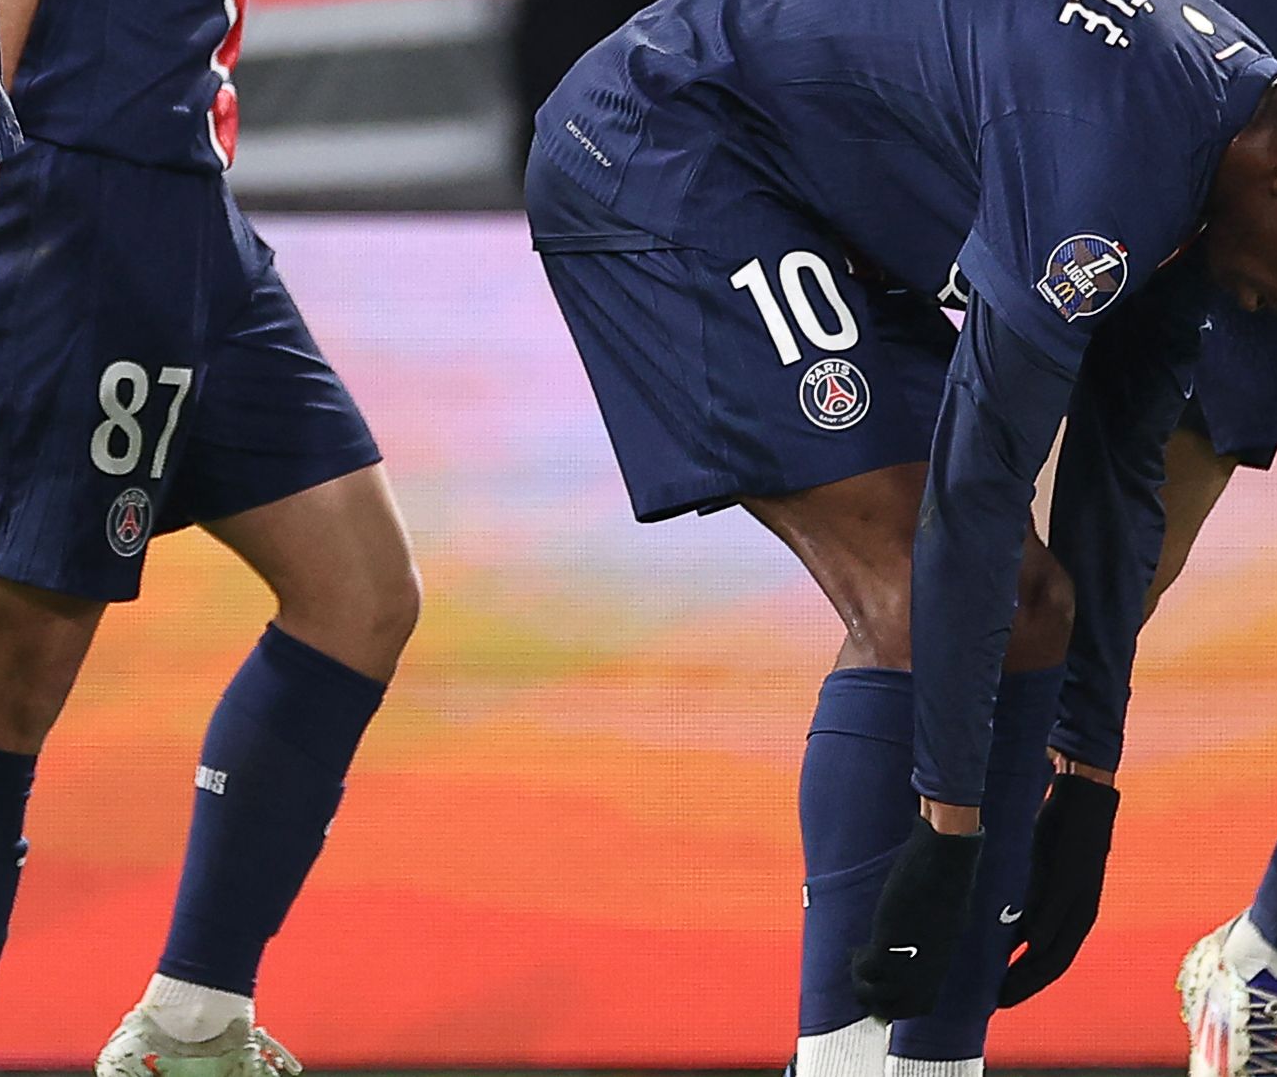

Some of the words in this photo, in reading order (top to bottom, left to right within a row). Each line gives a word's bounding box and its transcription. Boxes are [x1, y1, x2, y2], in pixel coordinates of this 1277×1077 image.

[730, 250, 859, 365] 10
[90, 361, 194, 479] 87
[806, 363, 851, 386] PARIS
